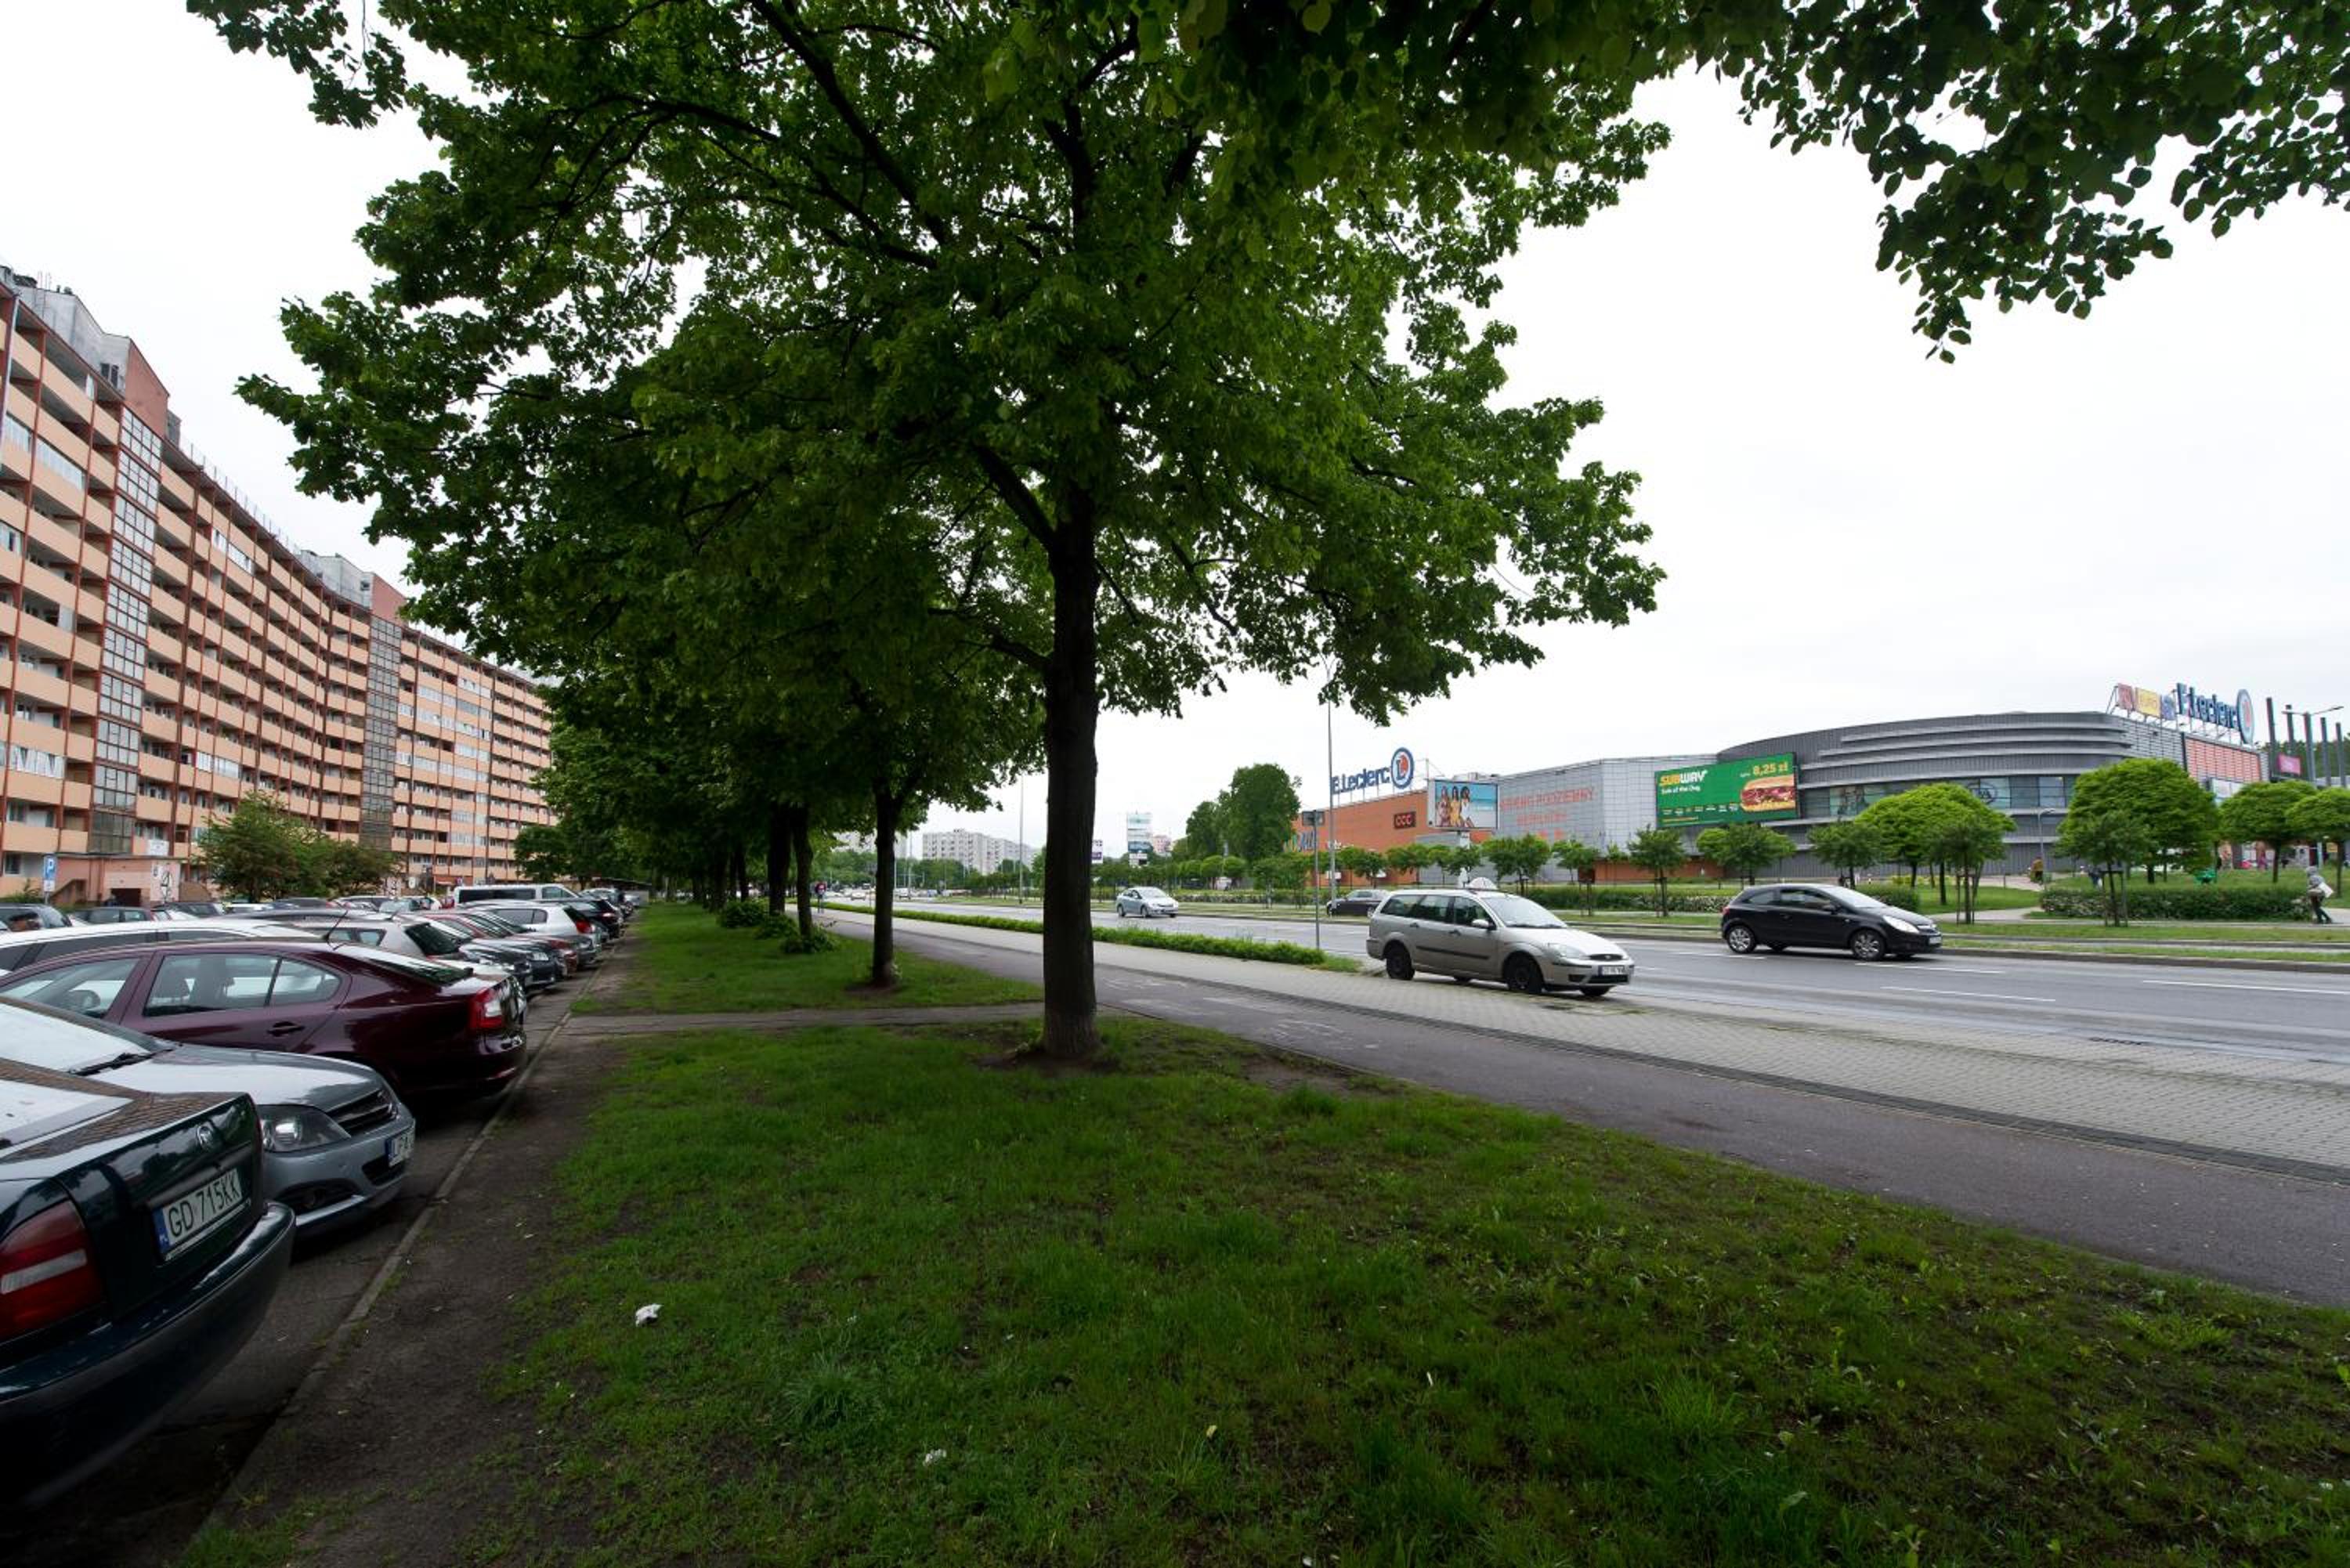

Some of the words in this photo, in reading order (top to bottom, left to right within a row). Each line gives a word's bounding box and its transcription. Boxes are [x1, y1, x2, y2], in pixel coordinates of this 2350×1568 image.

[1752, 764, 1776, 775] 8,25
[1660, 771, 1707, 786] SUBWAY
[168, 1201, 193, 1237] GD
[196, 1173, 240, 1222] 715KK
